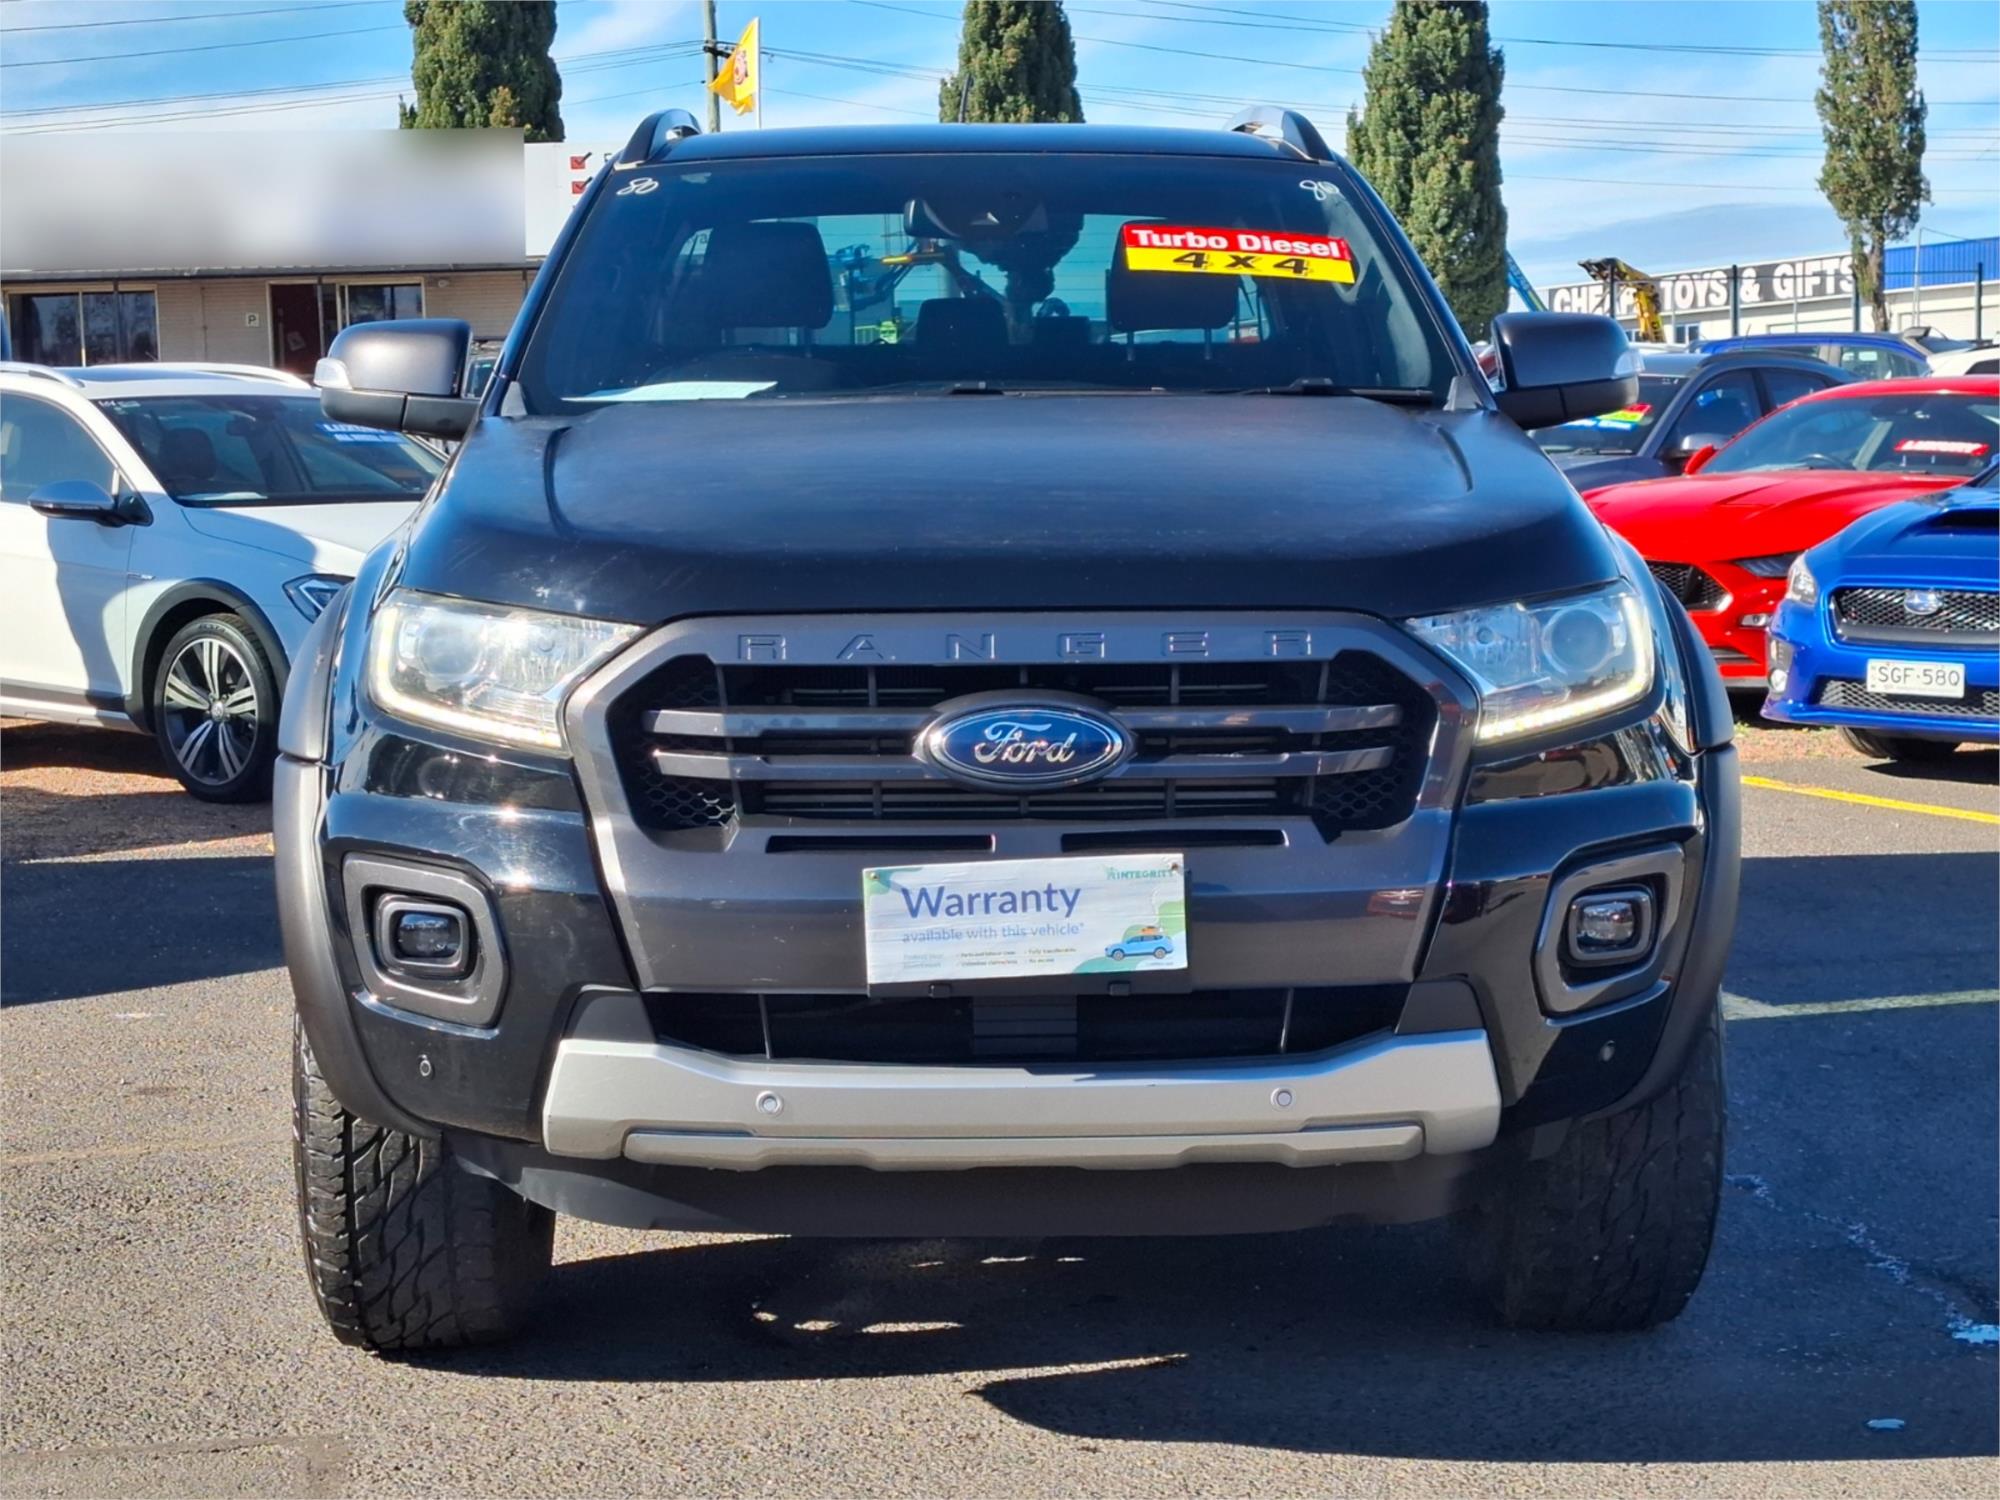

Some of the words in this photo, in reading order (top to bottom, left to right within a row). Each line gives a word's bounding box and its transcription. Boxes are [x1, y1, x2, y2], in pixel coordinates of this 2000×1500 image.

[1131, 229, 1228, 249] Turbo
[1237, 233, 1341, 257] Diesel
[1660, 270, 1729, 311] TOYS
[1740, 267, 1761, 302] &
[1772, 254, 1854, 300] GIFTS
[737, 632, 1312, 663] RANGER
[974, 721, 1077, 763] Ford
[901, 882, 1081, 919] Warranty
[902, 929, 963, 943] available
[967, 926, 998, 939] with
[1002, 924, 1029, 937] this
